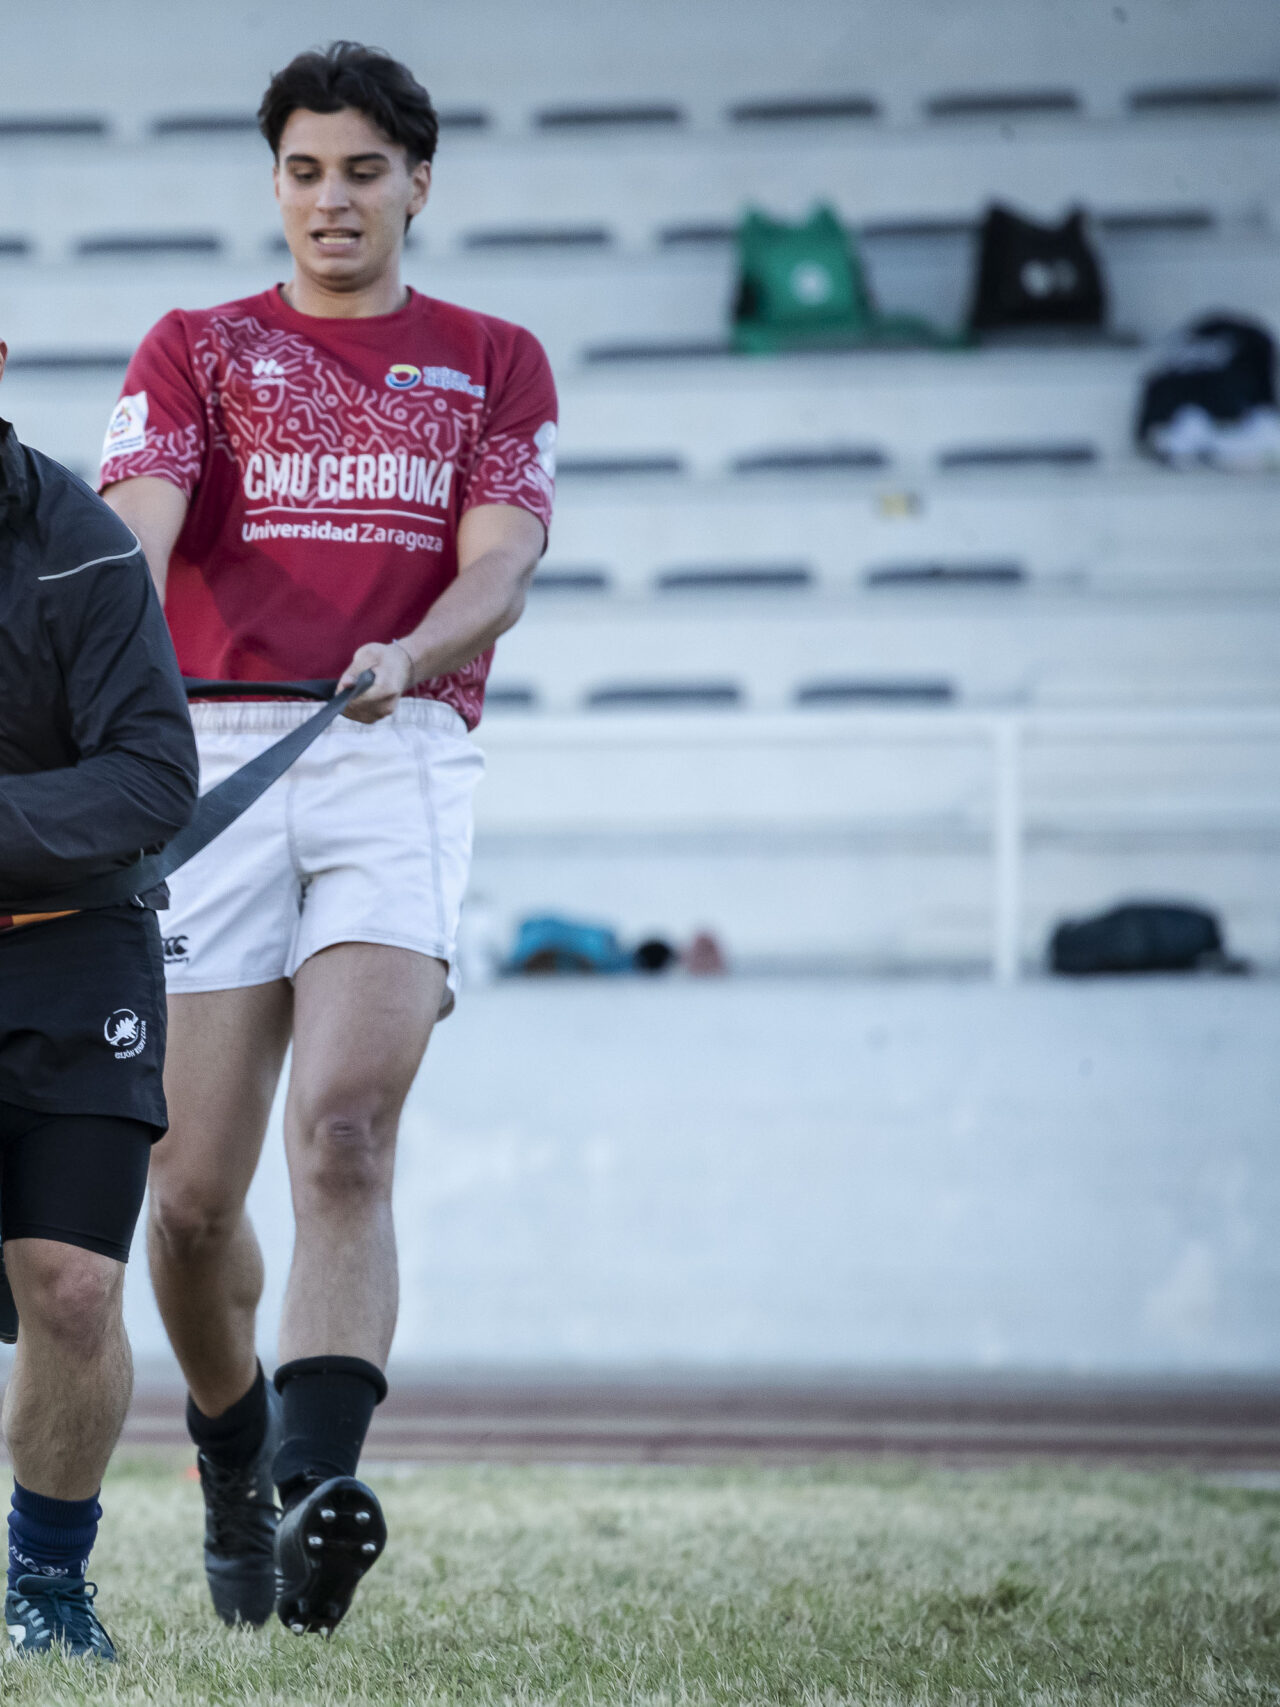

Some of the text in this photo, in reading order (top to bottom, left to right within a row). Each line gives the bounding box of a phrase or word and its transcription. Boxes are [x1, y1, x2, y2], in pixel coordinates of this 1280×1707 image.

[244, 453, 453, 509] CMU CERBUNA
[242, 520, 444, 552] Universidad Zaragoza
